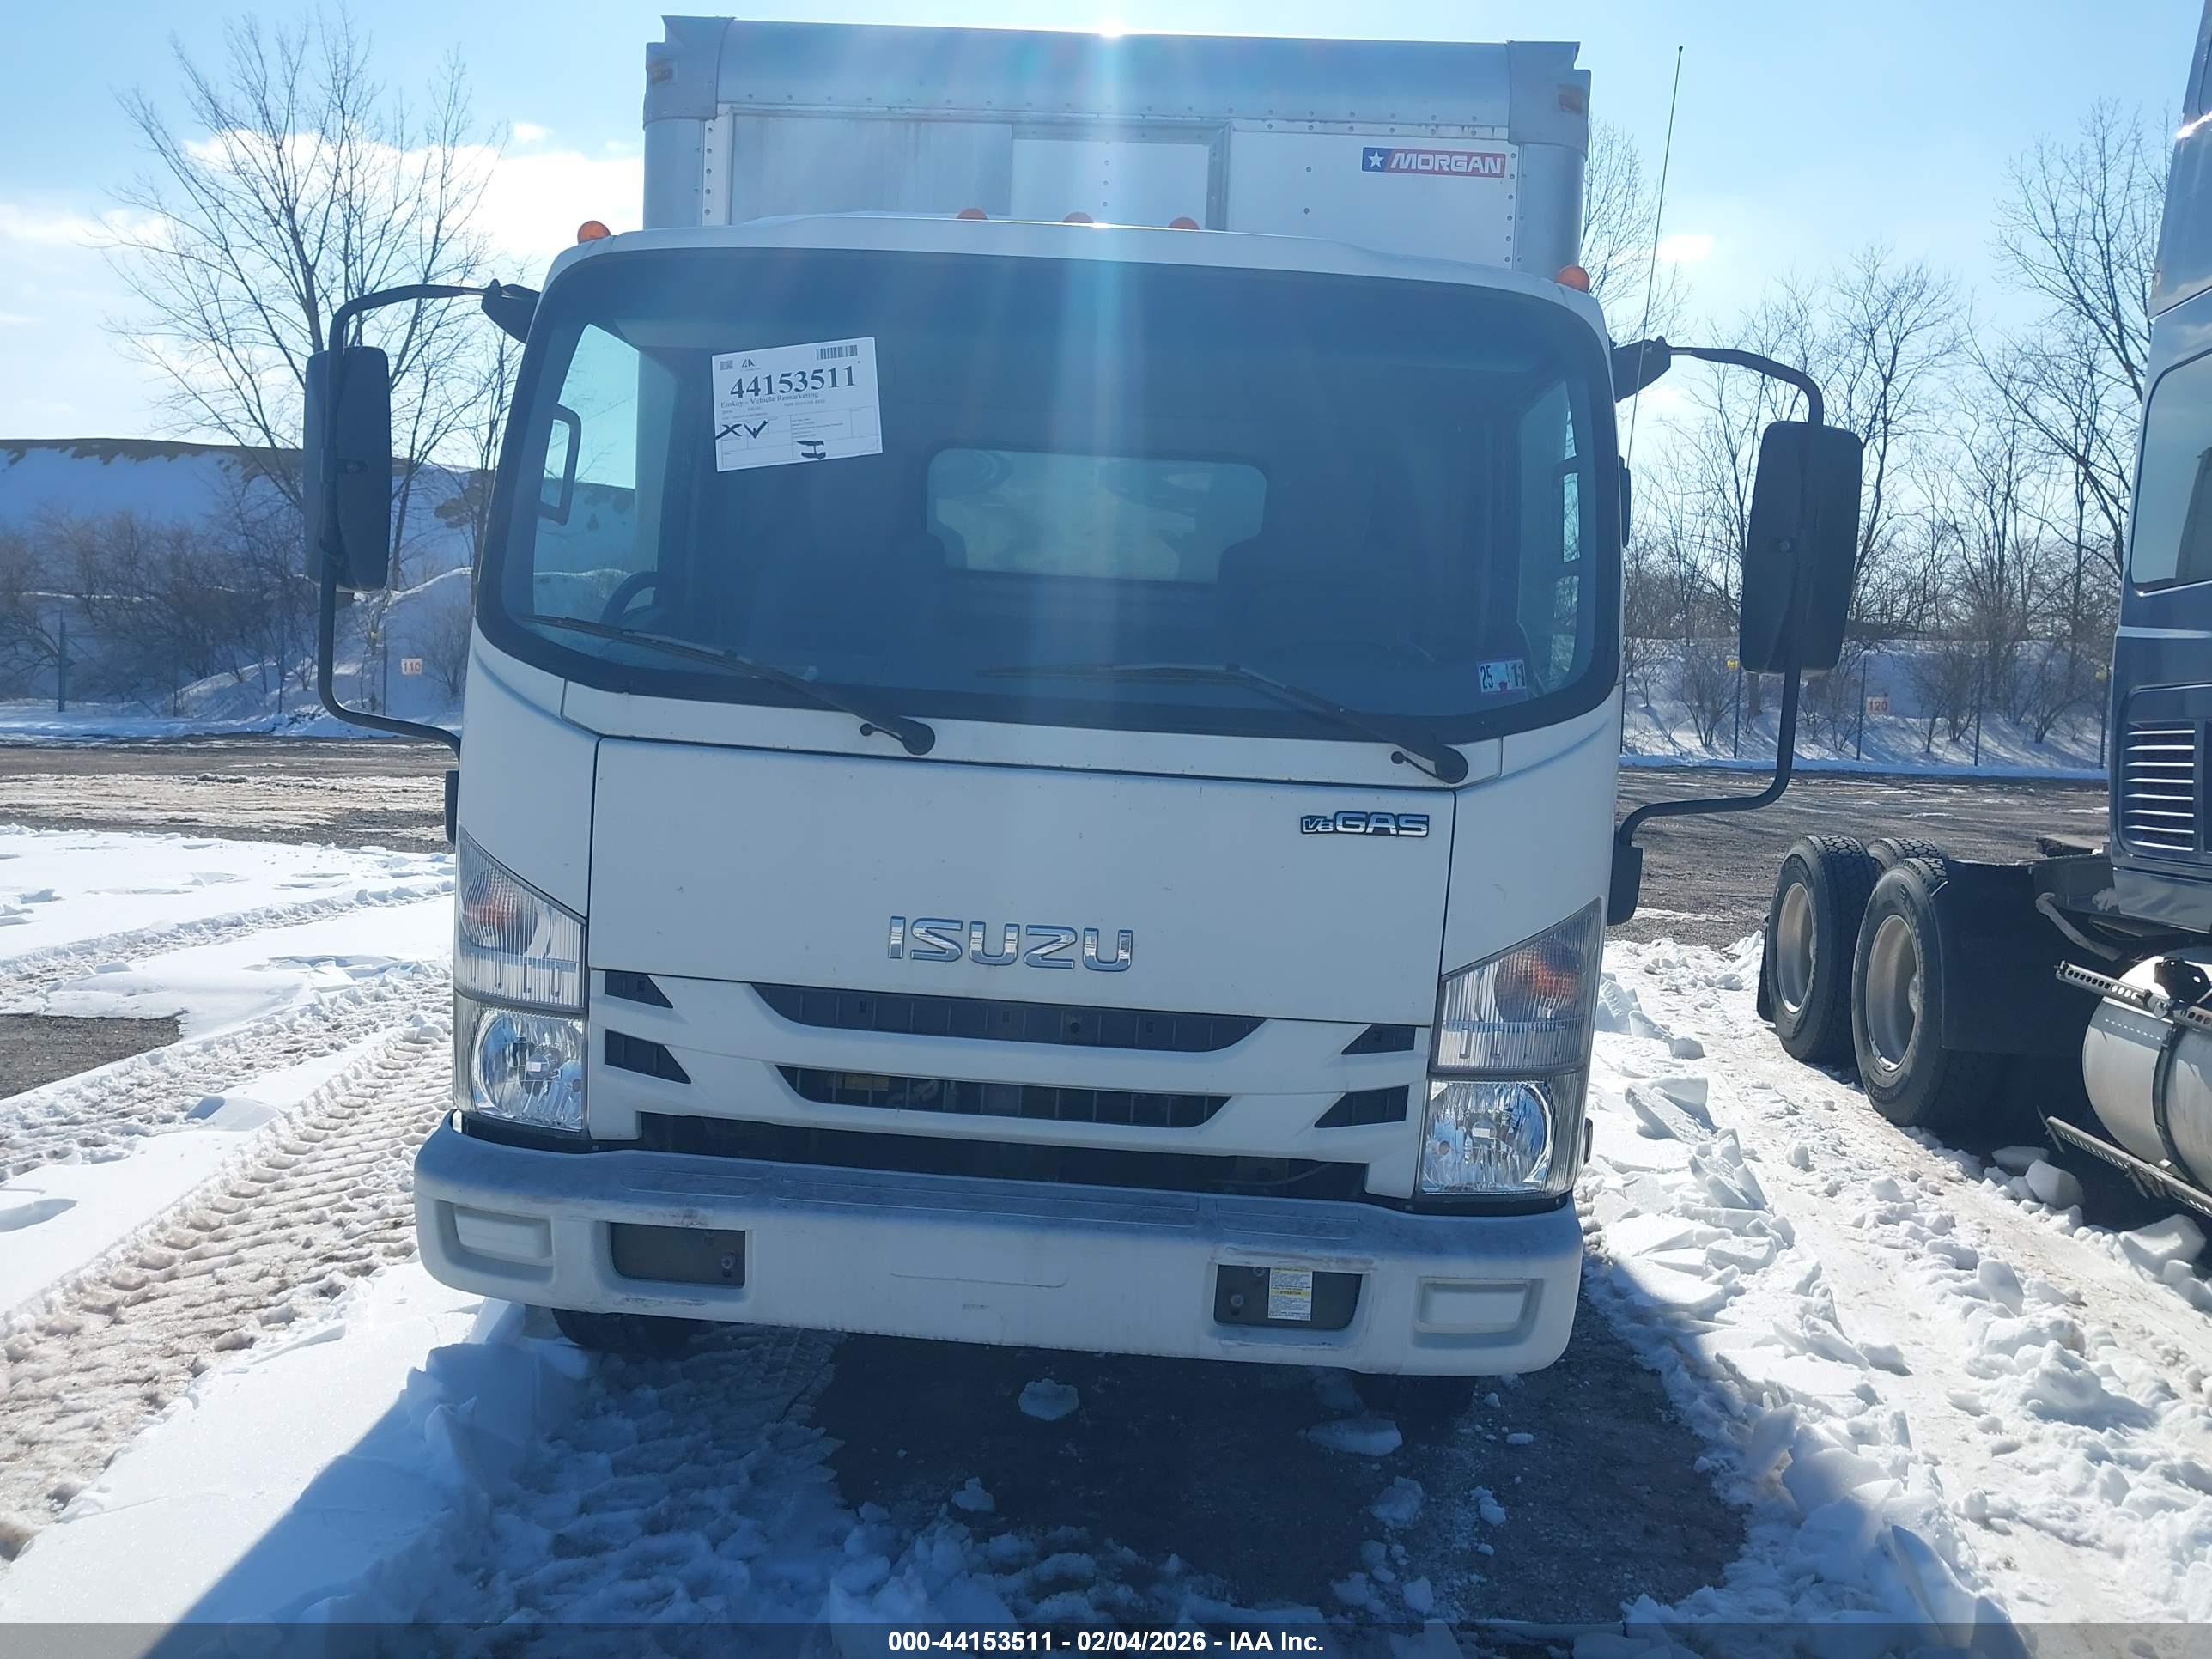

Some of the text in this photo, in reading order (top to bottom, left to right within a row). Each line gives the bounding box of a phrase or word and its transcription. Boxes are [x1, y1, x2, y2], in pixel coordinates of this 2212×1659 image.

[1390, 152, 1502, 174] MORGAN
[729, 365, 858, 398] 44153511
[750, 395, 775, 404] Vehicle
[777, 392, 819, 401] Remarketing
[1480, 665, 1494, 689] 25
[1869, 701, 1888, 712] 120
[1334, 811, 1430, 838] GAS
[888, 915, 1134, 973] ISUZU
